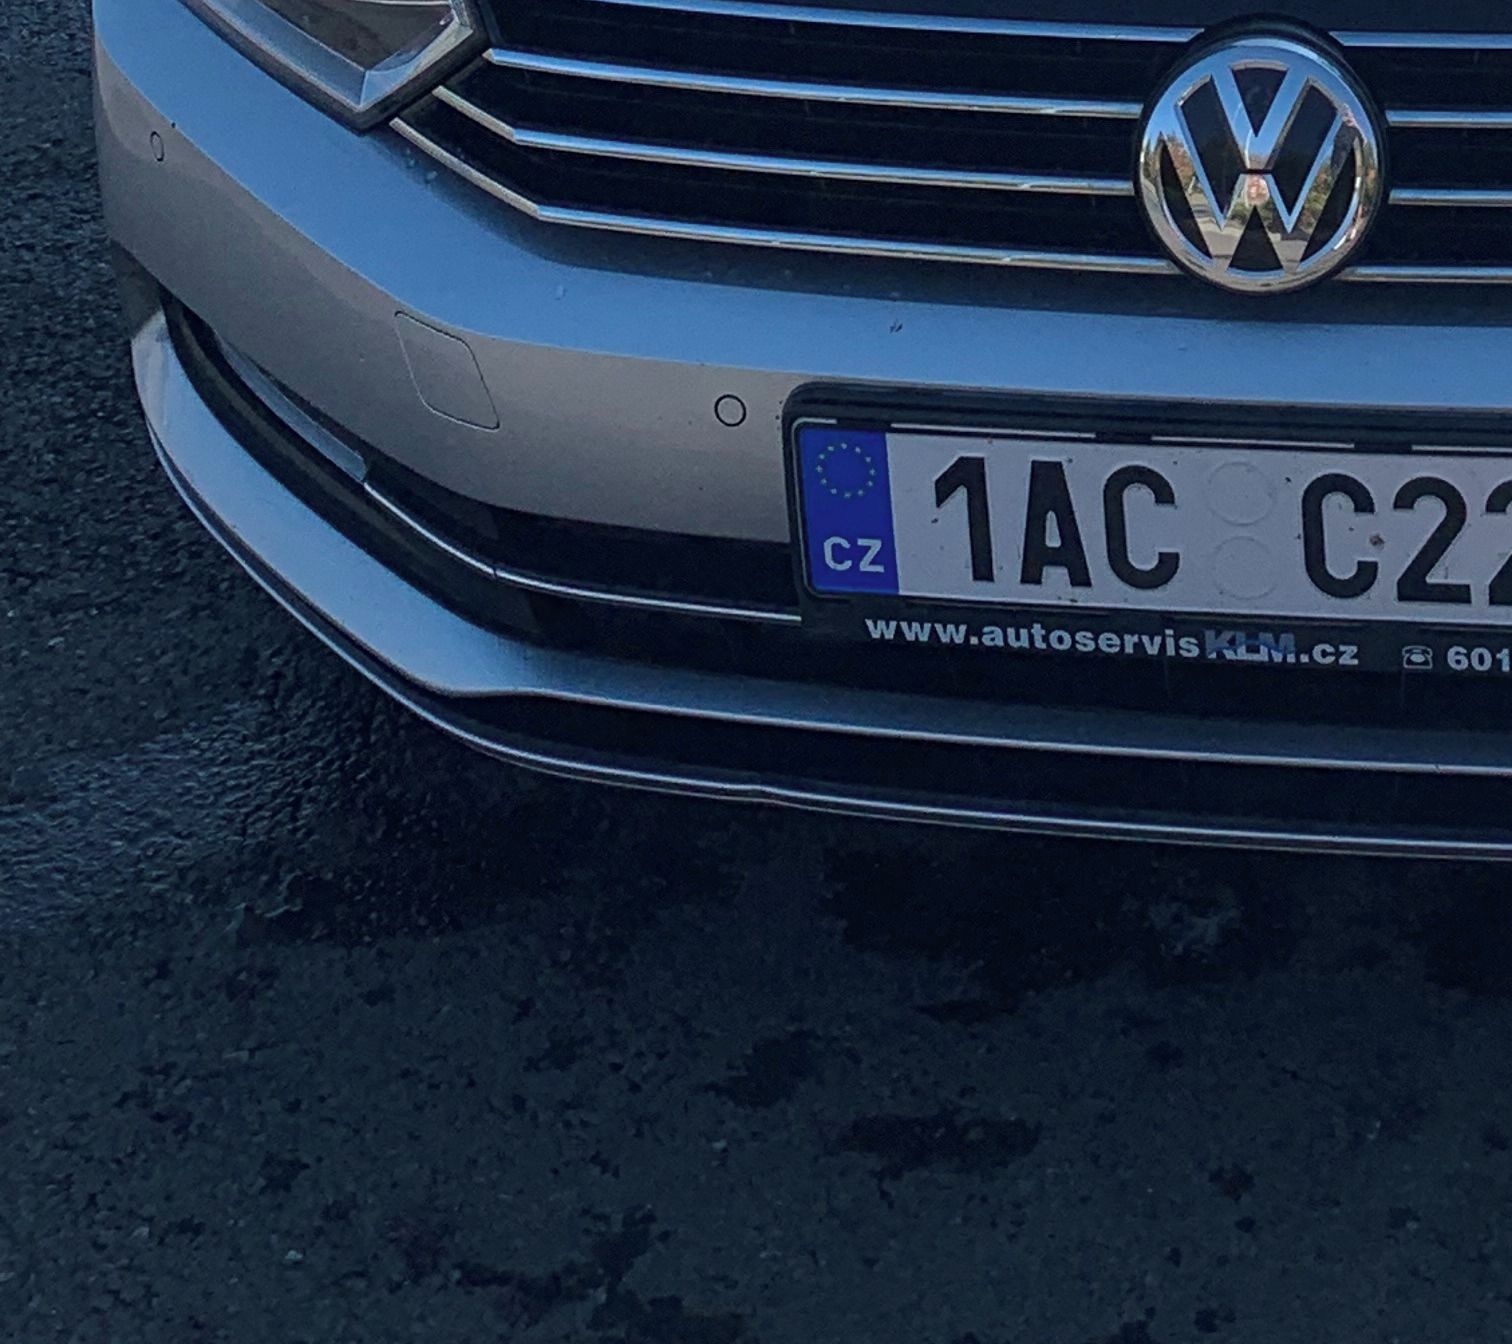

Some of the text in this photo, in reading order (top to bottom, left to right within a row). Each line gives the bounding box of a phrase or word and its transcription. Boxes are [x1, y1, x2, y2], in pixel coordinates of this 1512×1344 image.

[934, 455, 1181, 590] 1AC
[822, 535, 886, 574] CZ
[864, 617, 1360, 666] www.autoservisKLM.cz
[1446, 644, 1512, 673] 601
